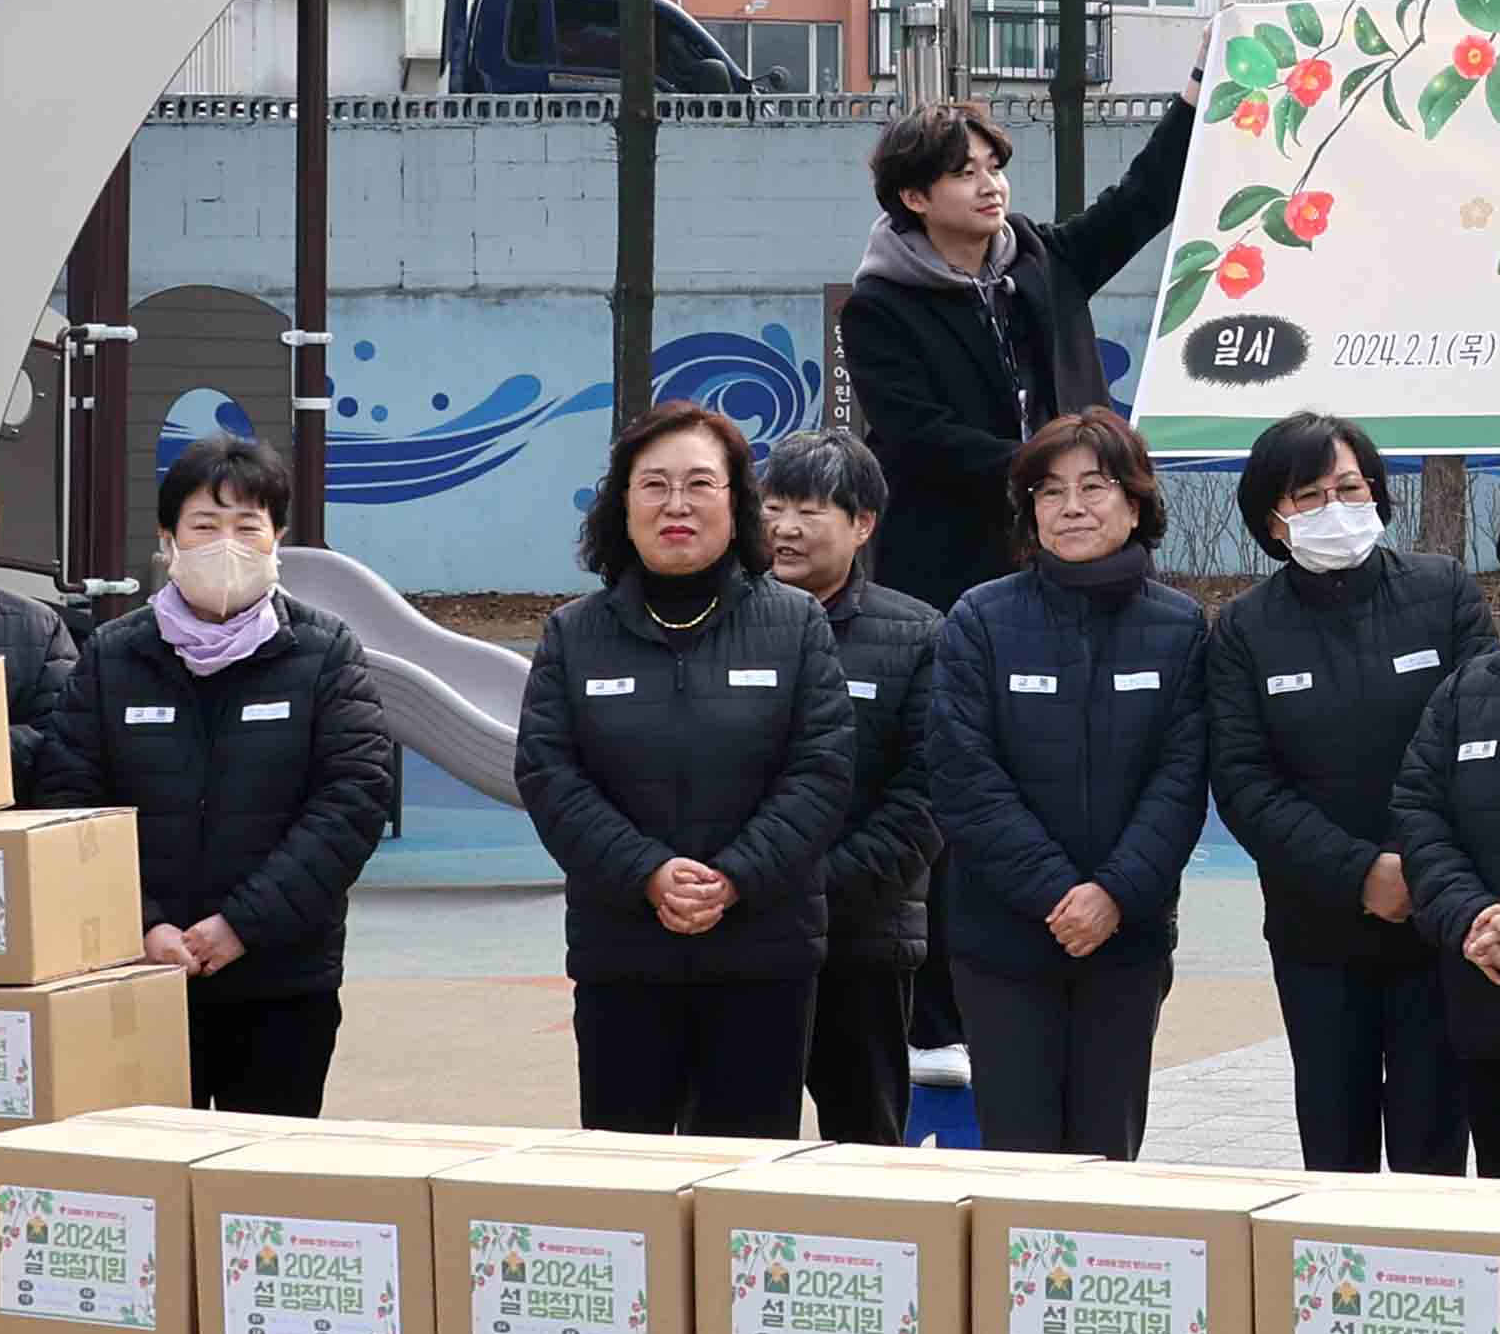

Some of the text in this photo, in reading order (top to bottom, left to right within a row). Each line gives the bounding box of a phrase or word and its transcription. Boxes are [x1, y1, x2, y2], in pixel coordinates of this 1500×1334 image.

[1214, 327, 1274, 366] 일시
[1332, 329, 1496, 371] 2024.2.1.(목)
[531, 1259, 613, 1291] 2024년
[1079, 1274, 1171, 1309] 2024년
[500, 1286, 614, 1323] 설 명절지원
[1042, 1305, 1066, 1334] 설
[1368, 1289, 1464, 1327] 2024년
